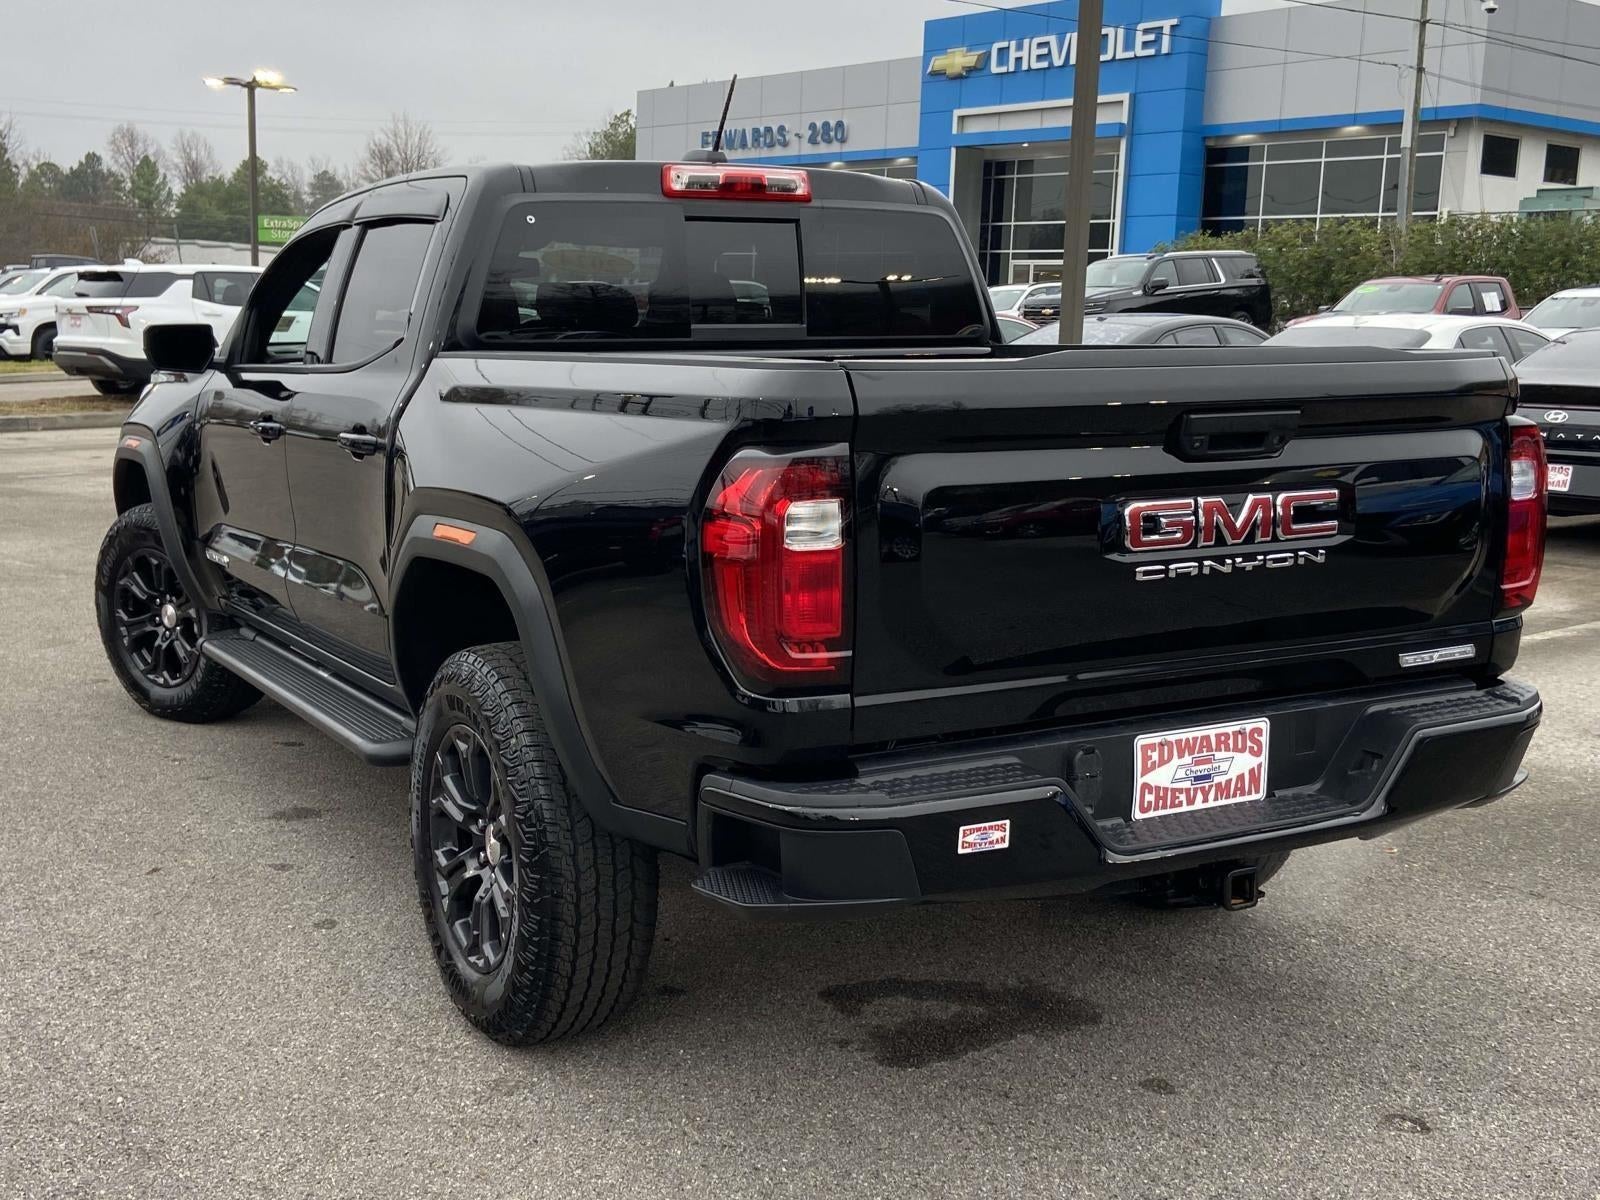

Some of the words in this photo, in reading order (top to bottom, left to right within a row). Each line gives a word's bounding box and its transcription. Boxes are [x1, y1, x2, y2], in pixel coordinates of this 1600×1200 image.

[807, 120, 847, 145] 280
[1124, 488, 1339, 552] GMC
[1135, 549, 1326, 582] CANYON
[1140, 726, 1264, 778] EDWARDS
[1184, 764, 1221, 777] Chevrolet
[1138, 762, 1263, 815] CHEVYMAN
[961, 834, 1006, 850] CHEVYMAN
[962, 822, 1008, 839] EDWARDS
